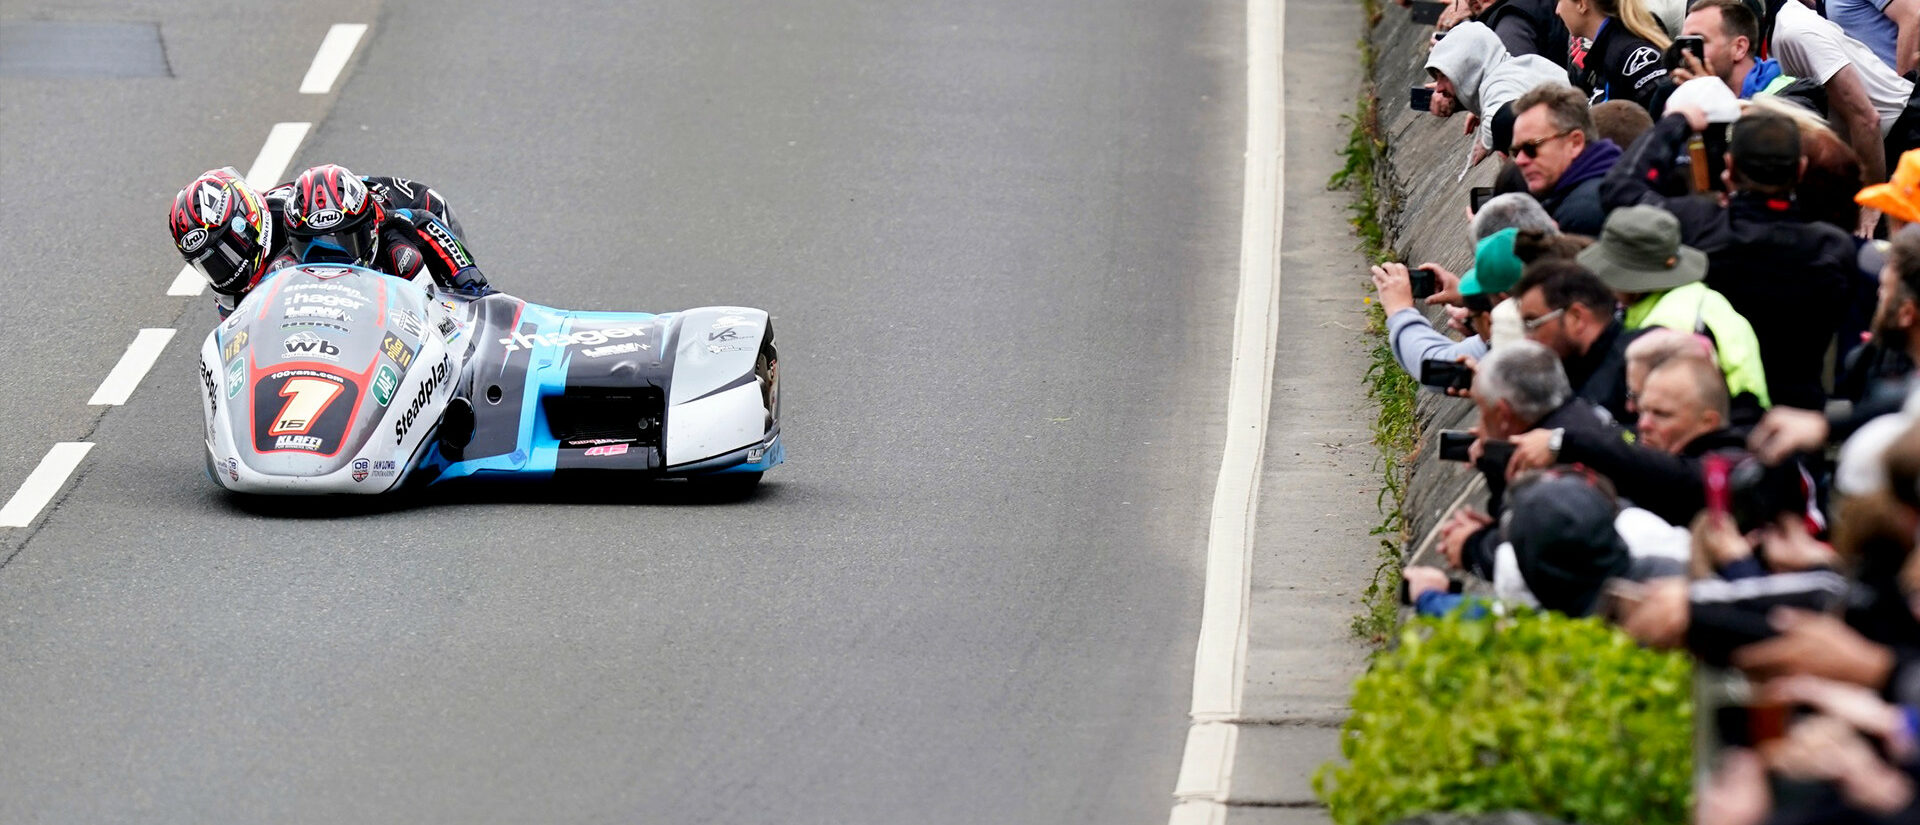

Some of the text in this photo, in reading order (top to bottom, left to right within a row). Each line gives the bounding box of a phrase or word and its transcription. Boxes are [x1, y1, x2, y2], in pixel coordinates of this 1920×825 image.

[311, 211, 338, 225] Arai
[184, 230, 204, 247] Arai
[285, 340, 340, 356] wb
[271, 370, 344, 383] 100vans.com
[270, 377, 343, 435] 1
